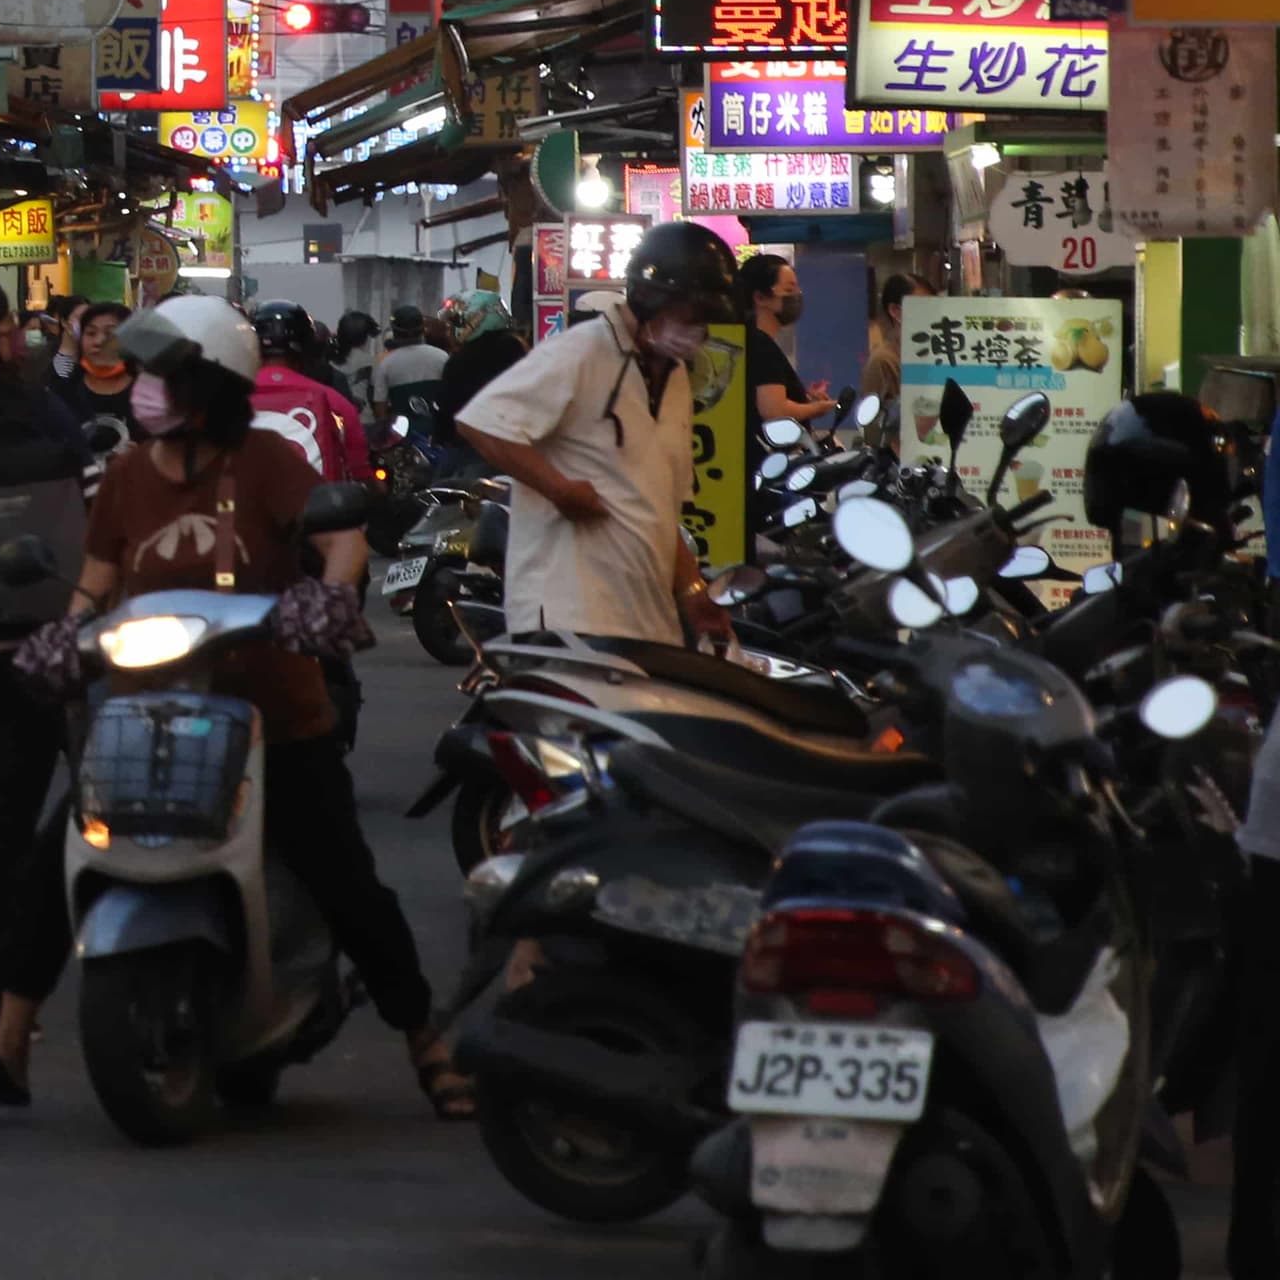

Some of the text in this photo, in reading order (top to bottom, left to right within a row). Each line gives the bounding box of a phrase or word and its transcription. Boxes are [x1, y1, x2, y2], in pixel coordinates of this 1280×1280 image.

[721, 90, 828, 137] 筒仔米糕
[1062, 237, 1097, 270] 20
[736, 1053, 921, 1104] J2P-335
